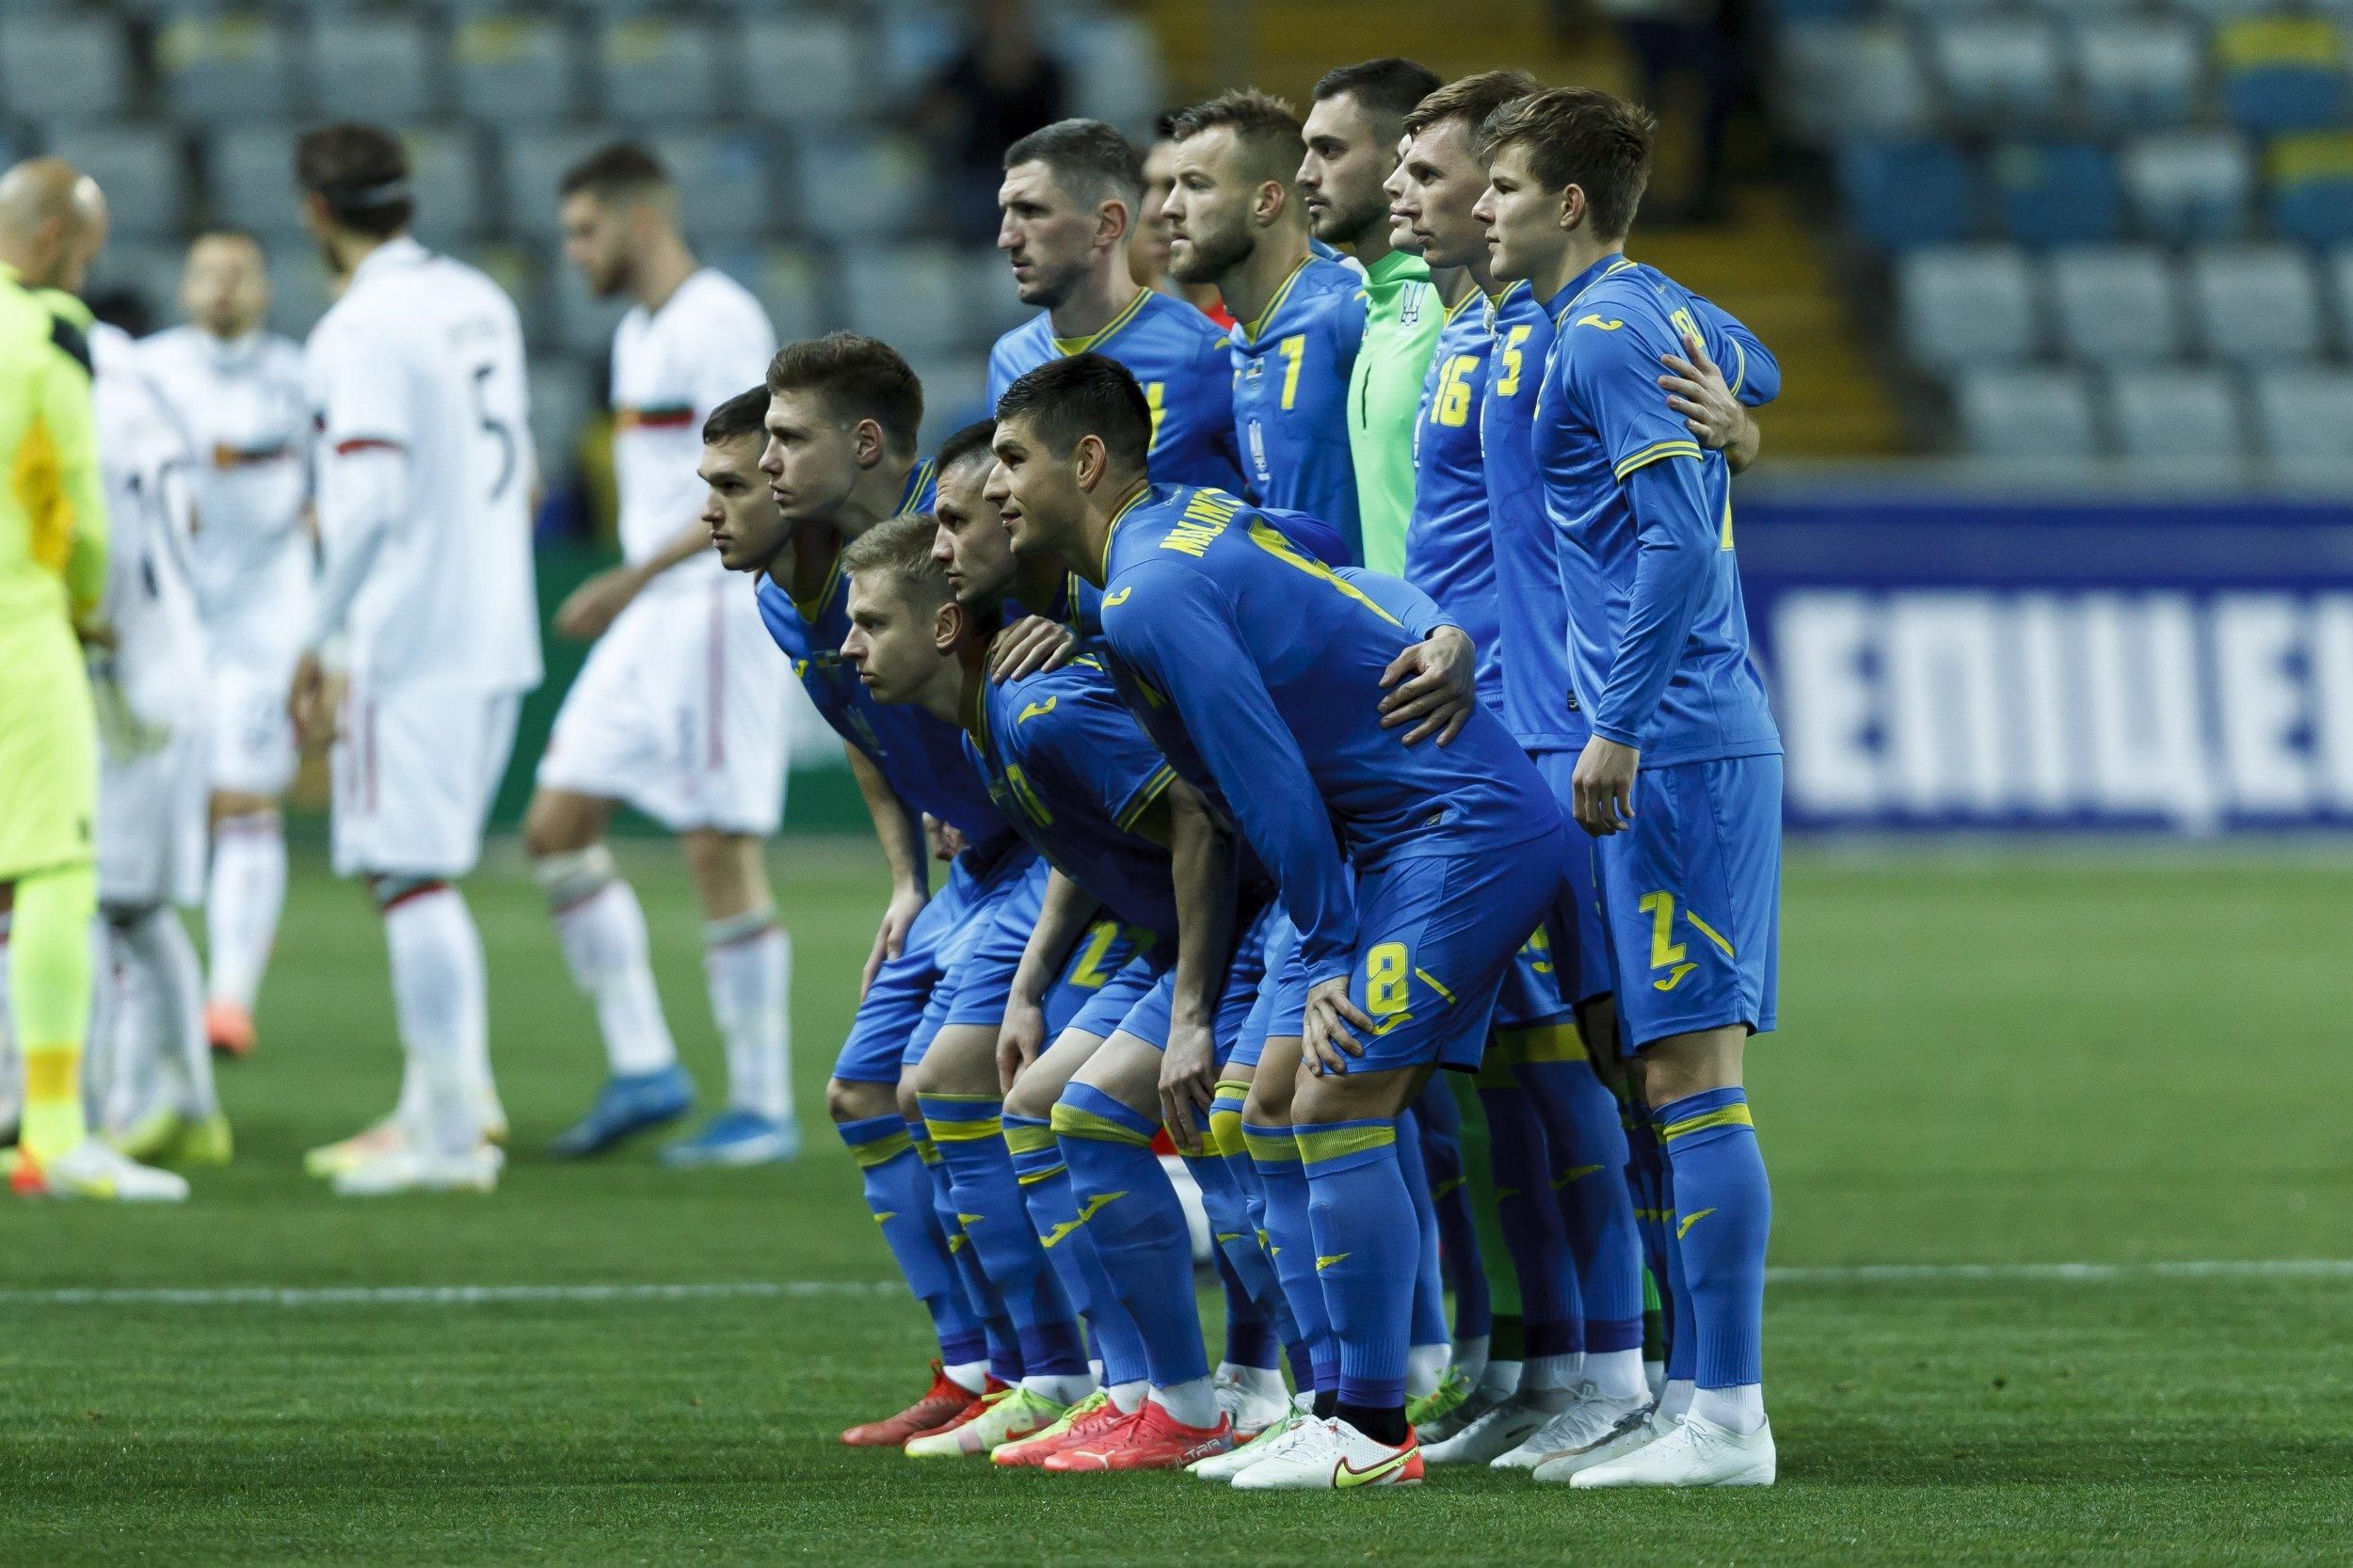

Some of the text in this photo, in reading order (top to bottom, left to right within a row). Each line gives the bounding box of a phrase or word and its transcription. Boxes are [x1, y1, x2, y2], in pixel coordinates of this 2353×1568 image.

[1278, 333, 1305, 409] 7
[1430, 352, 1480, 427] 16
[1497, 325, 1532, 396] 5
[1639, 890, 1687, 969] 2
[1366, 942, 1409, 1016] 8
